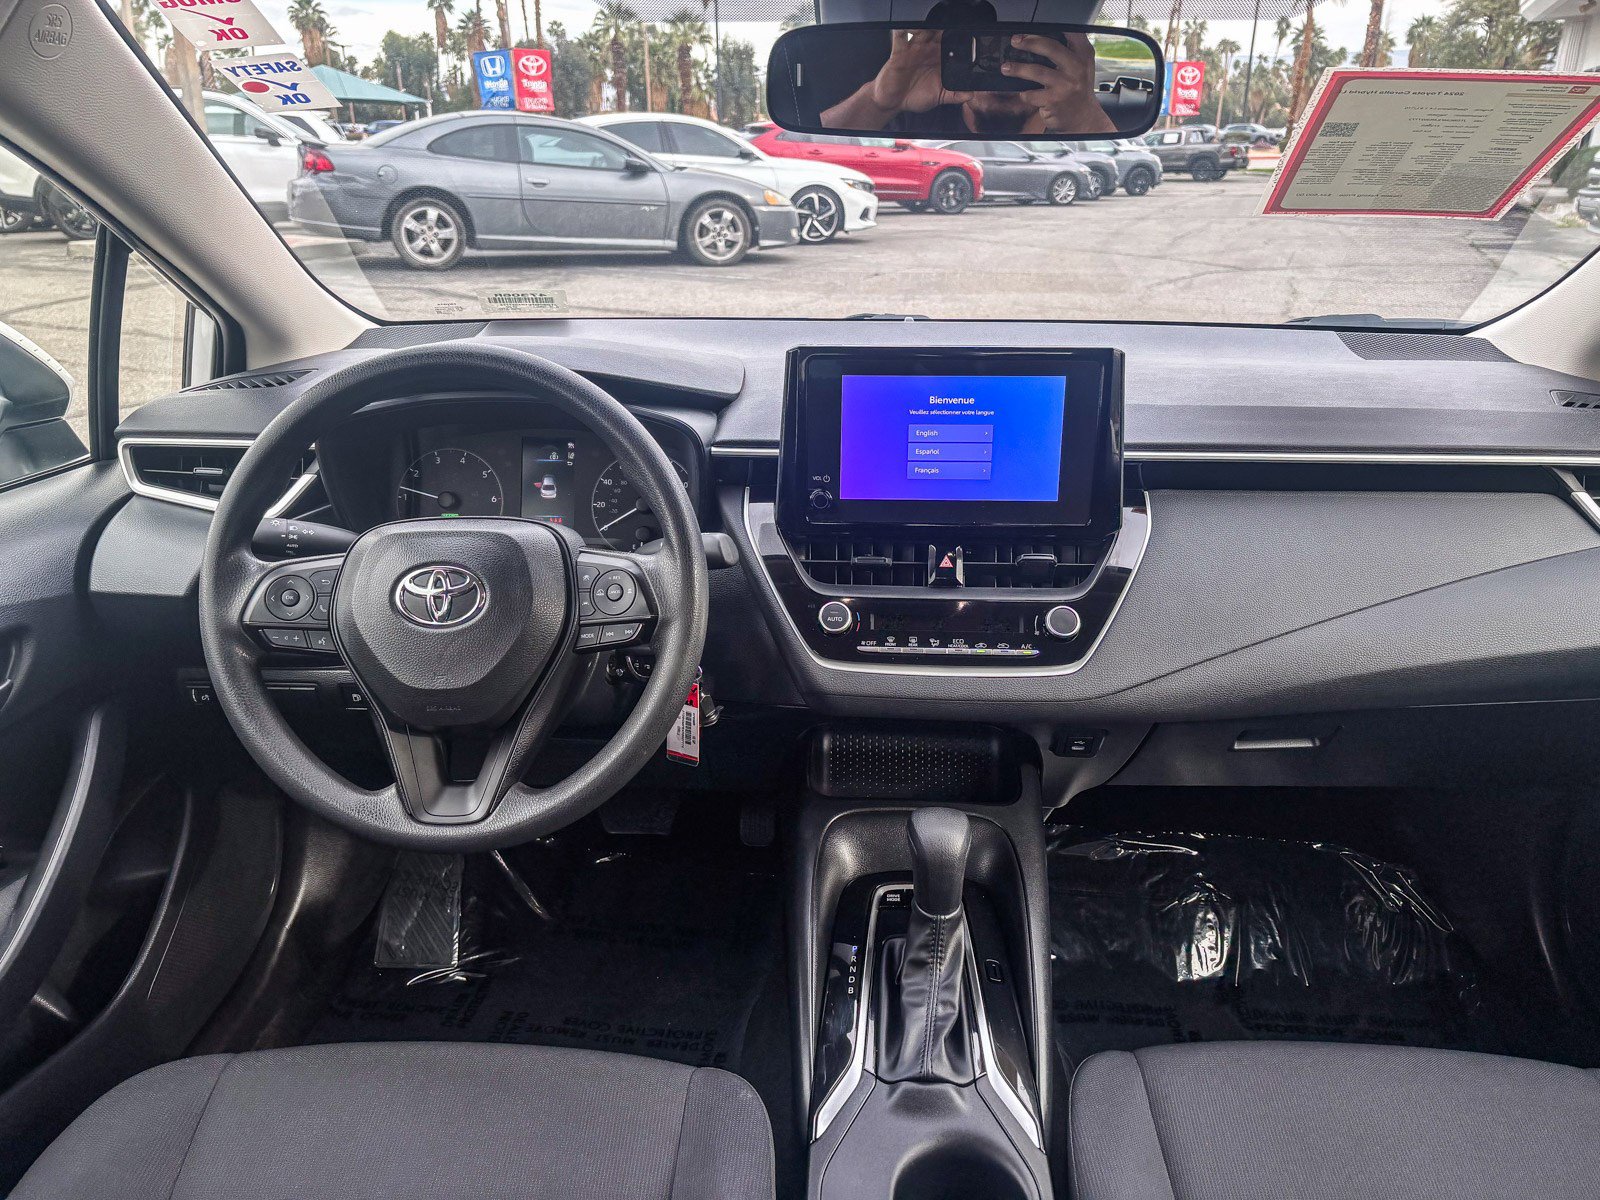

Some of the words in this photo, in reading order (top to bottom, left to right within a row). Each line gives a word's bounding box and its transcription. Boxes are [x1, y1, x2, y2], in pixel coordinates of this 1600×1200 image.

[34, 29, 68, 47] AIRBAG
[929, 395, 975, 405] Bienvenue
[930, 408, 961, 416] sélectionner
[975, 409, 995, 417] langue
[915, 429, 939, 438] English
[915, 448, 940, 456] Español
[435, 456, 441, 464] 3
[459, 456, 466, 464] 4
[413, 470, 419, 478] 2
[482, 470, 488, 479] 5
[914, 466, 940, 475] Français
[491, 495, 497, 503] 6
[851, 955, 857, 963] R
[850, 965, 857, 973] N
